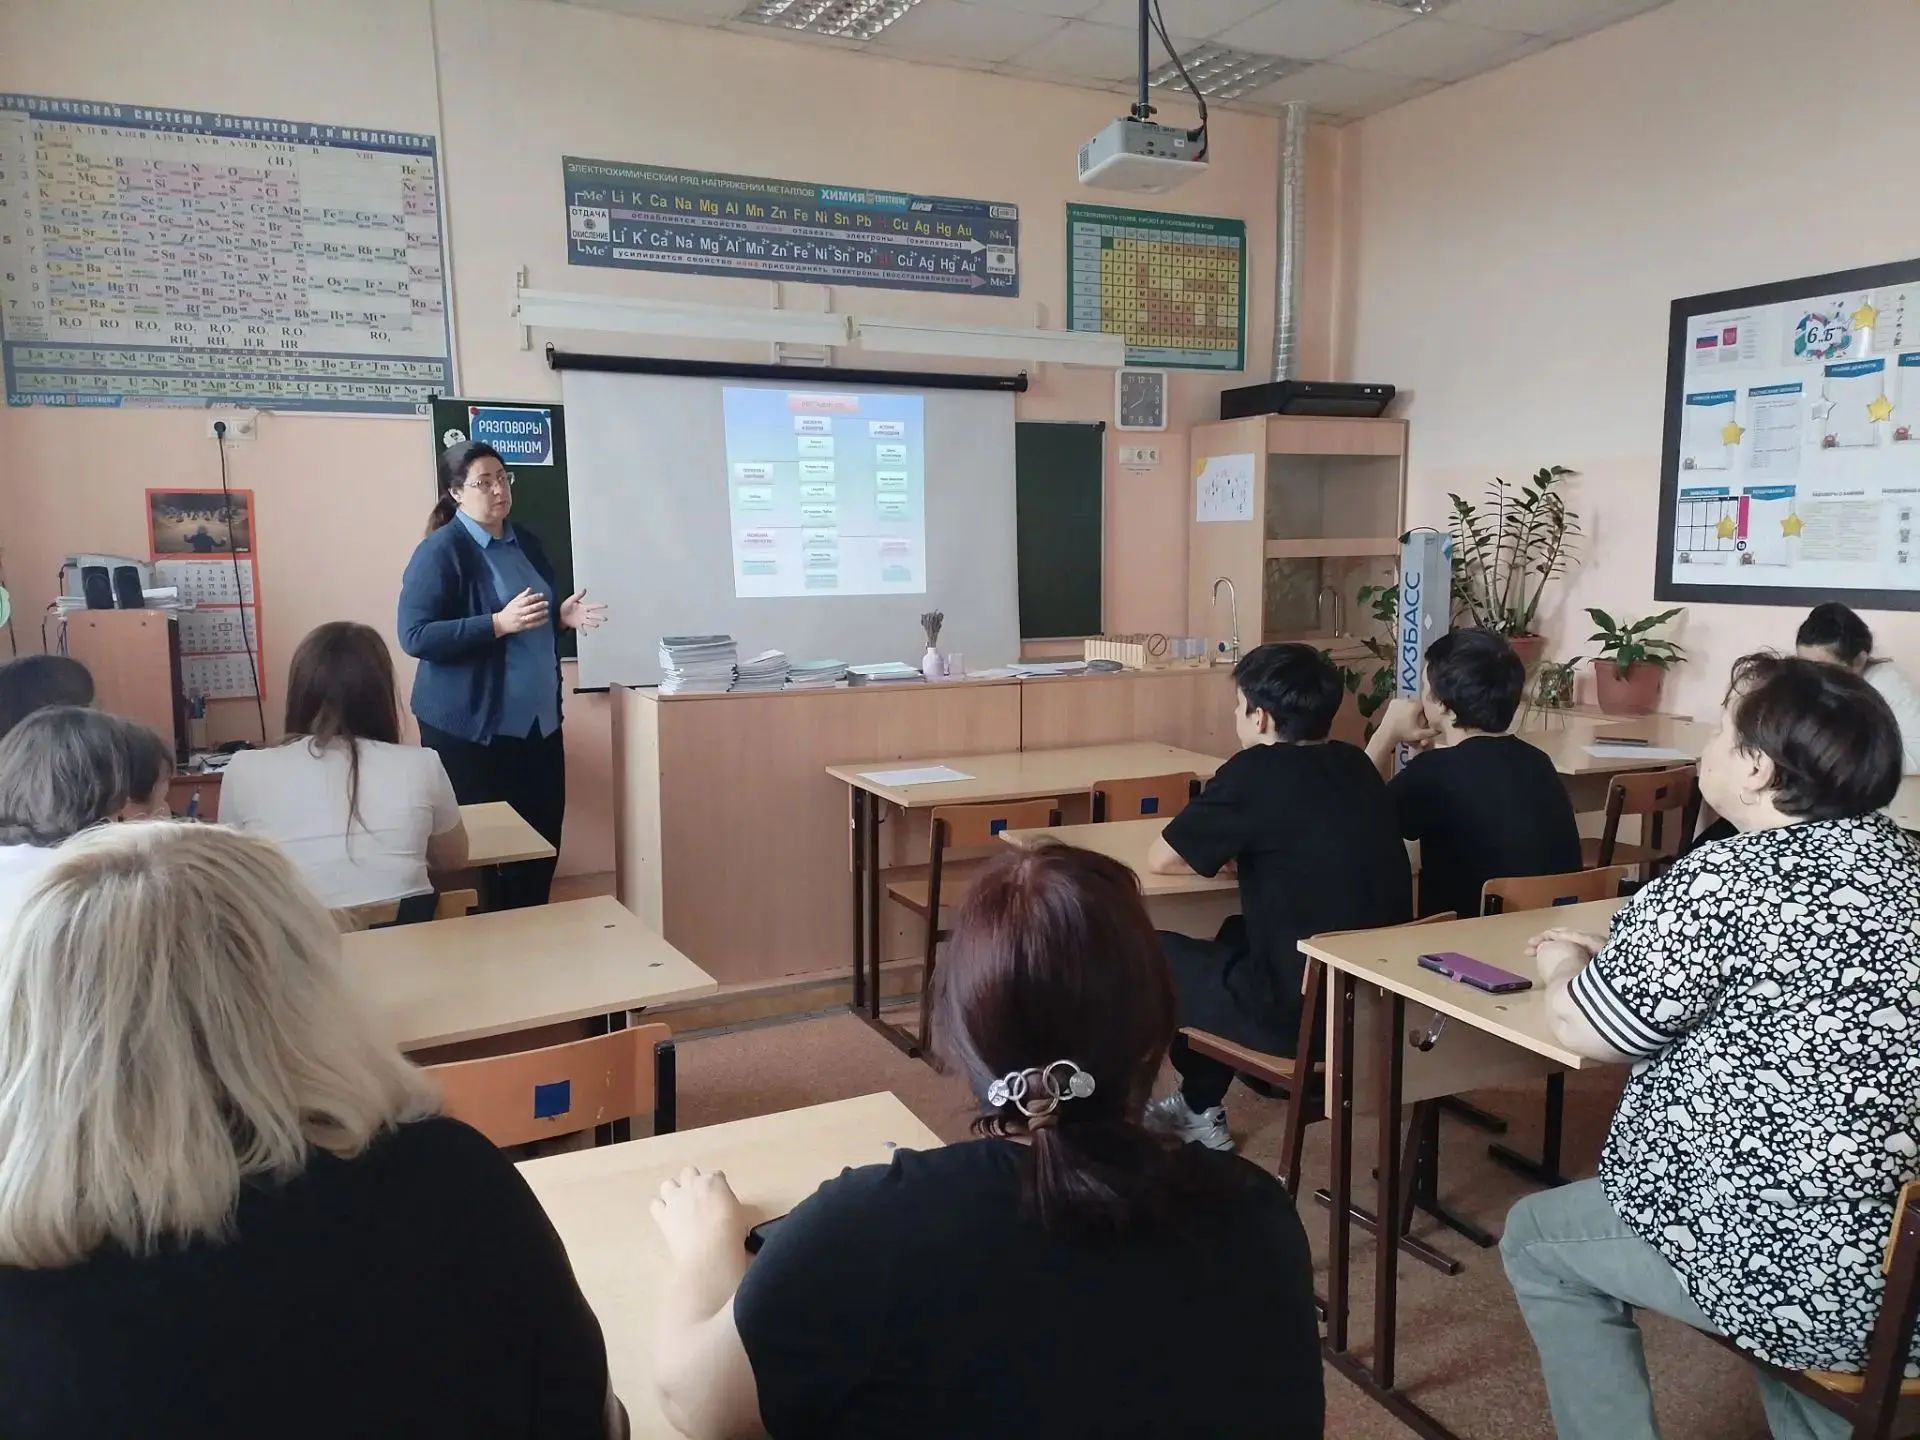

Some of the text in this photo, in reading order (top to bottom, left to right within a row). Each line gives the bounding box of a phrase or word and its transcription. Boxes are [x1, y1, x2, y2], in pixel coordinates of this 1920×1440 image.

[134, 109, 202, 125] СИСТЕМА
[215, 117, 298, 134] ЭЛЕМЕНТОВ
[681, 176, 699, 186] РЯД
[767, 186, 815, 197] МЕТАЛЛОВ
[822, 190, 865, 204] ХИМИЯ
[572, 209, 607, 218] ОТДАЧА
[612, 190, 624, 203] Li
[632, 192, 642, 204] K
[650, 194, 667, 208] Ca
[675, 196, 692, 210] Na
[700, 199, 719, 215] Mg
[726, 202, 739, 214] Al
[746, 204, 764, 217] Mn
[770, 206, 787, 219] Zn
[794, 208, 809, 221] Fe
[815, 211, 828, 224] Ni
[834, 213, 849, 225] Sn
[856, 215, 872, 227] Pb
[893, 218, 909, 230] Cu
[915, 220, 930, 235] Ag
[936, 222, 951, 237] Hg
[957, 224, 972, 236] Au
[573, 230, 608, 240] ОКИСЛЕНИЕ
[1138, 375, 1145, 384] 12
[478, 420, 542, 435] РАЗГОВОРЫ
[492, 439, 542, 454] ВАЖНОМ
[1402, 571, 1420, 692] КУЗБАСС
